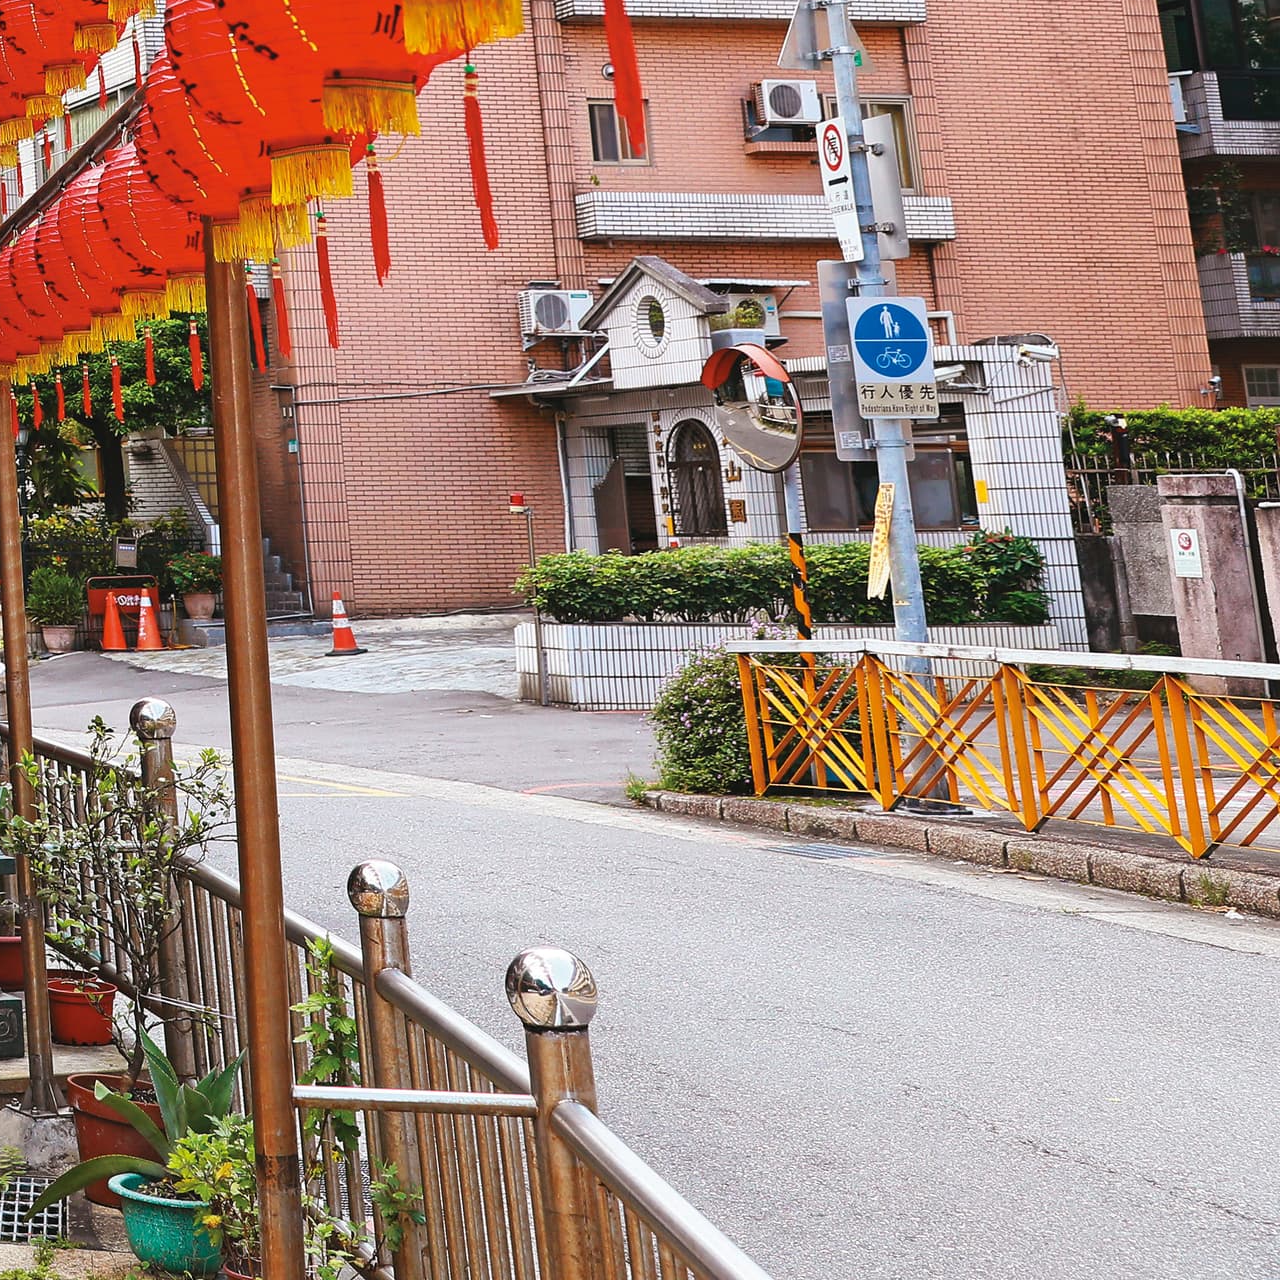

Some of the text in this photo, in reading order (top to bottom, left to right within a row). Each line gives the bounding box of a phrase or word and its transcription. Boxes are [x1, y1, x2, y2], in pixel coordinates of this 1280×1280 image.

[860, 384, 936, 400] 行人優先
[861, 403, 891, 413] Pedestrians
[892, 404, 904, 413] Have
[905, 403, 919, 415] Right
[926, 405, 936, 415] Way
